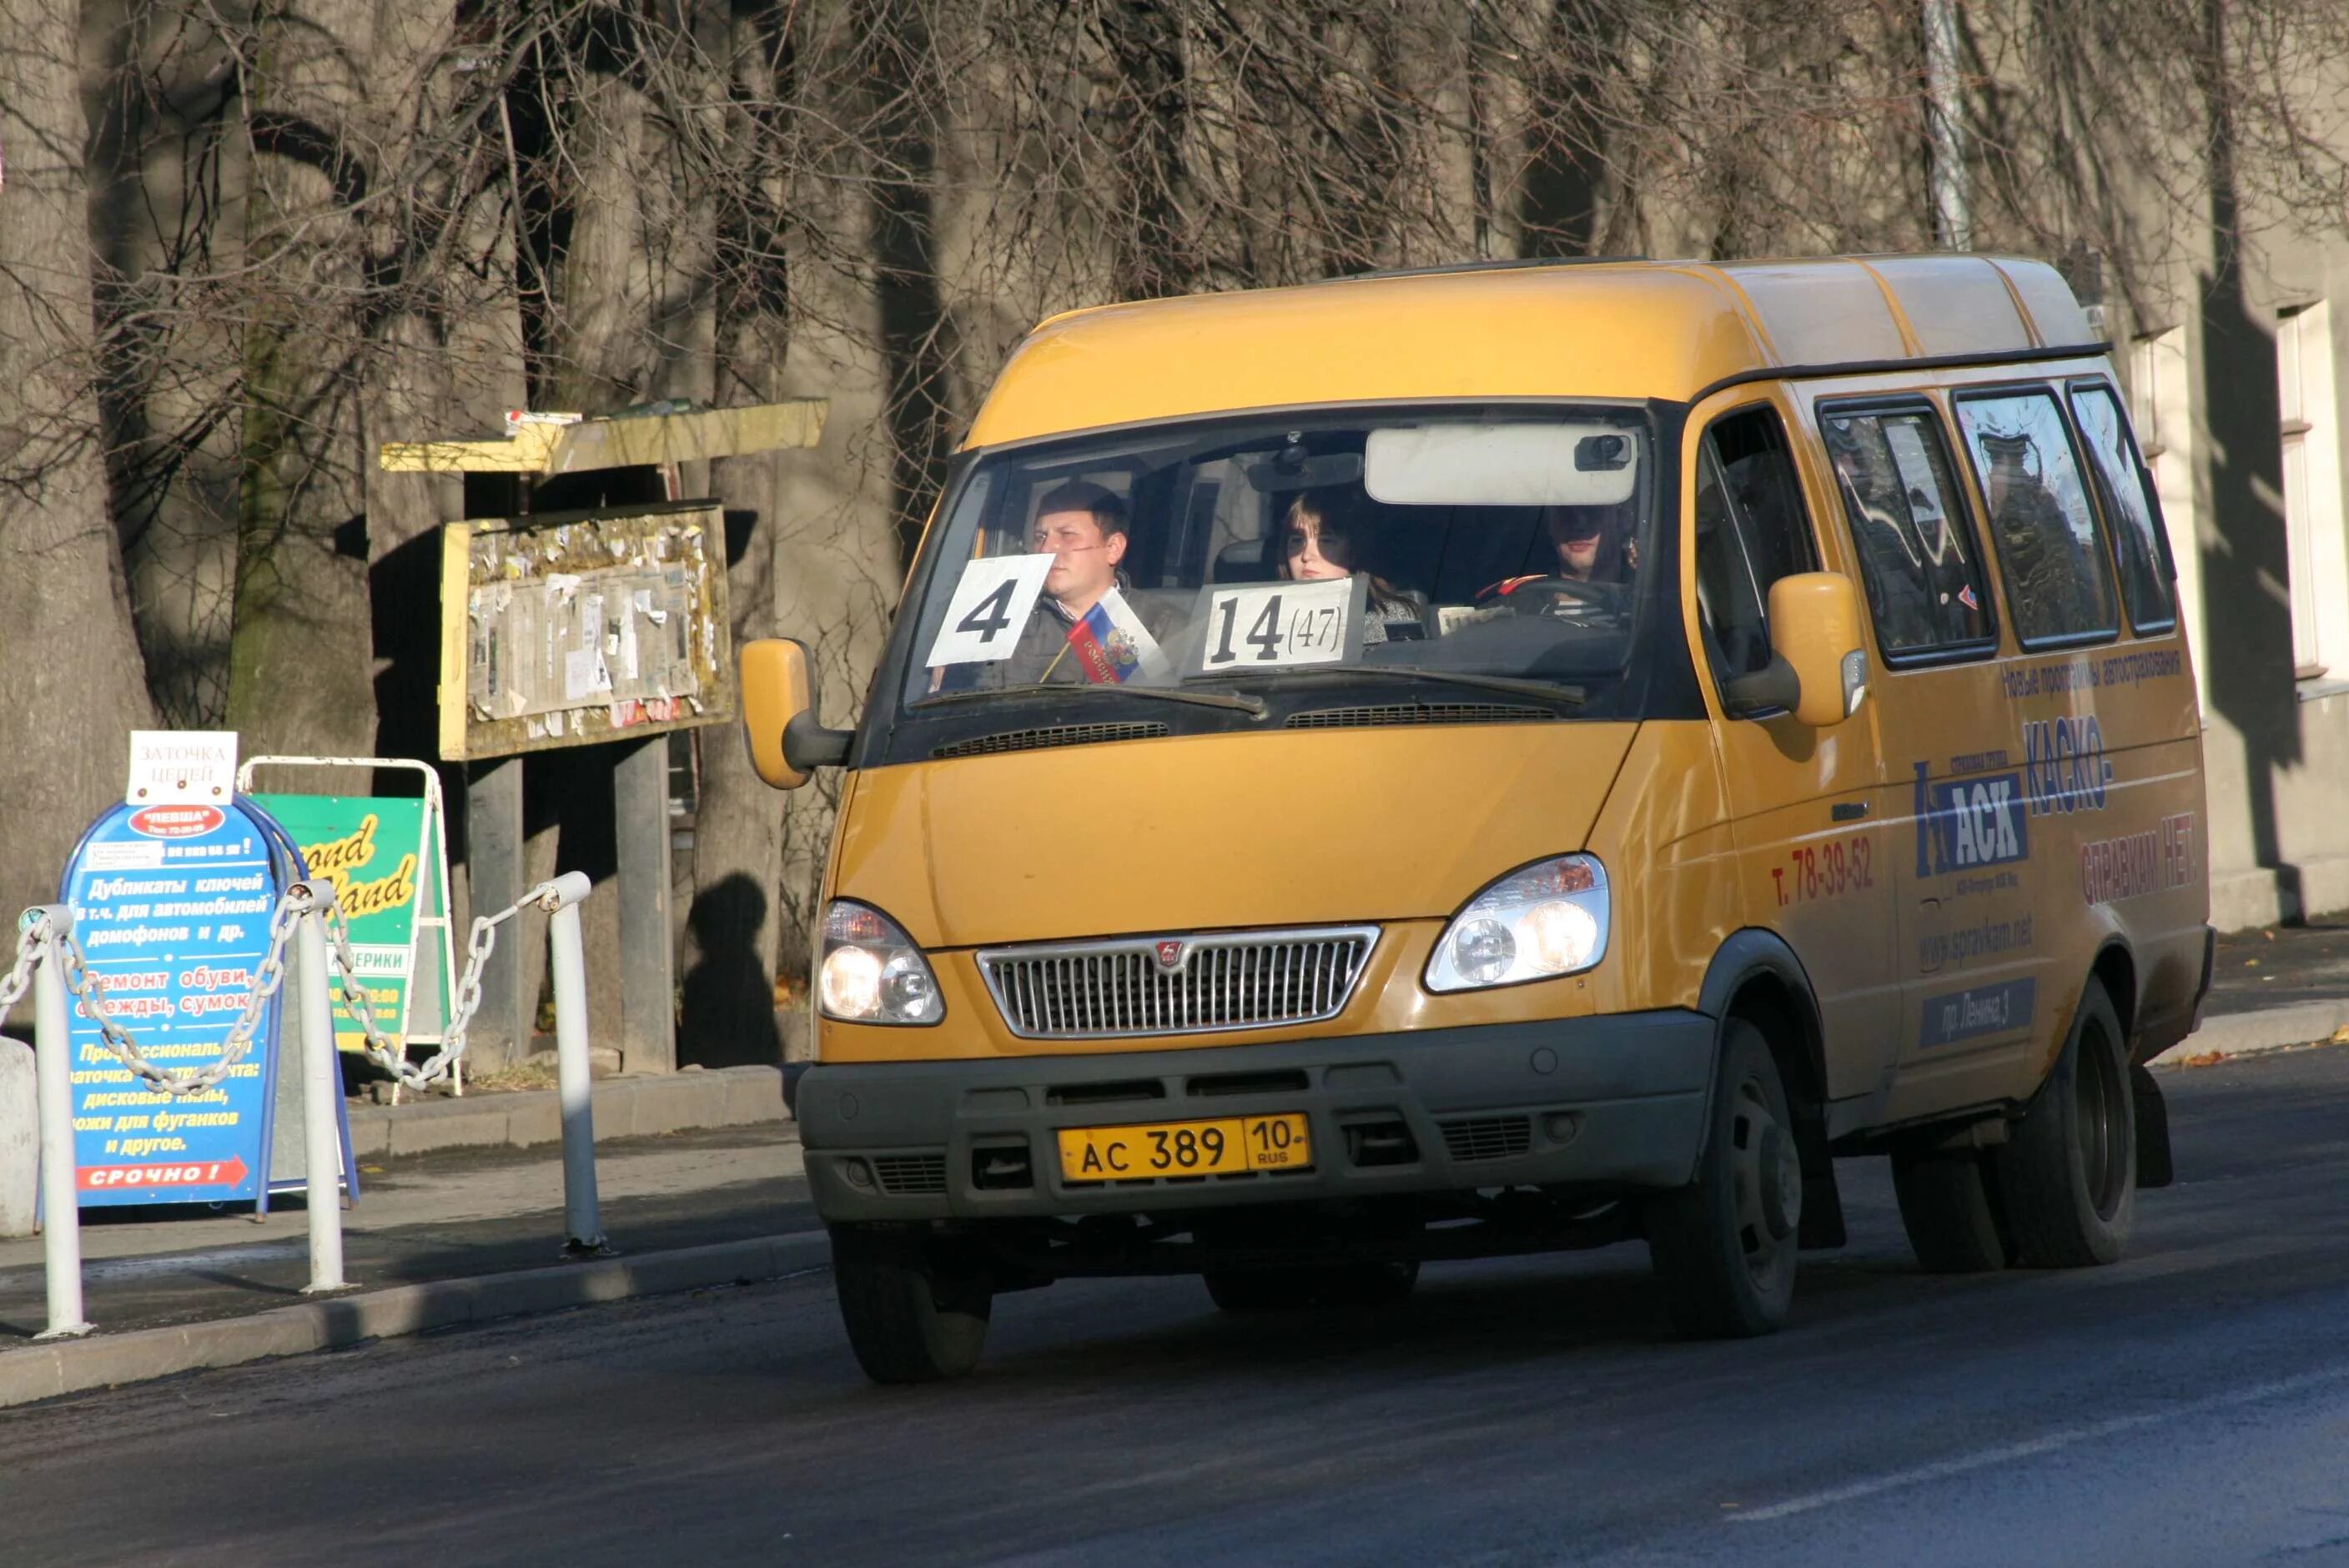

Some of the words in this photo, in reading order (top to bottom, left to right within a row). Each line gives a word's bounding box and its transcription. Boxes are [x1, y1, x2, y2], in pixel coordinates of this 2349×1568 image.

[955, 578, 1019, 643] 4
[1210, 594, 1282, 664] 14
[1288, 606, 1341, 654] (47)
[140, 746, 226, 761] ЗАТОЧКА
[152, 764, 214, 783] ЦЕПЕЙ
[1952, 781, 2019, 864] АСК
[303, 820, 372, 873] ond
[1792, 837, 1873, 902] 78-39-52
[88, 877, 188, 901] Дубликаты
[195, 872, 264, 892] ключей
[116, 902, 149, 922] для
[153, 896, 269, 917] автомобилей
[87, 926, 189, 947] домофонов
[198, 926, 210, 939] и
[179, 965, 254, 991] обуви,
[75, 996, 174, 1018] оежды,
[70, 1070, 133, 1084] аточка
[83, 1091, 174, 1110] дисковые
[114, 1114, 148, 1133] для
[153, 1111, 239, 1133] фуганков
[120, 1137, 187, 1157] другое.
[1147, 1128, 1225, 1168] 389
[1253, 1119, 1290, 1150] 10
[1257, 1151, 1289, 1165] RUS
[89, 1168, 200, 1185] СРОЧНО
